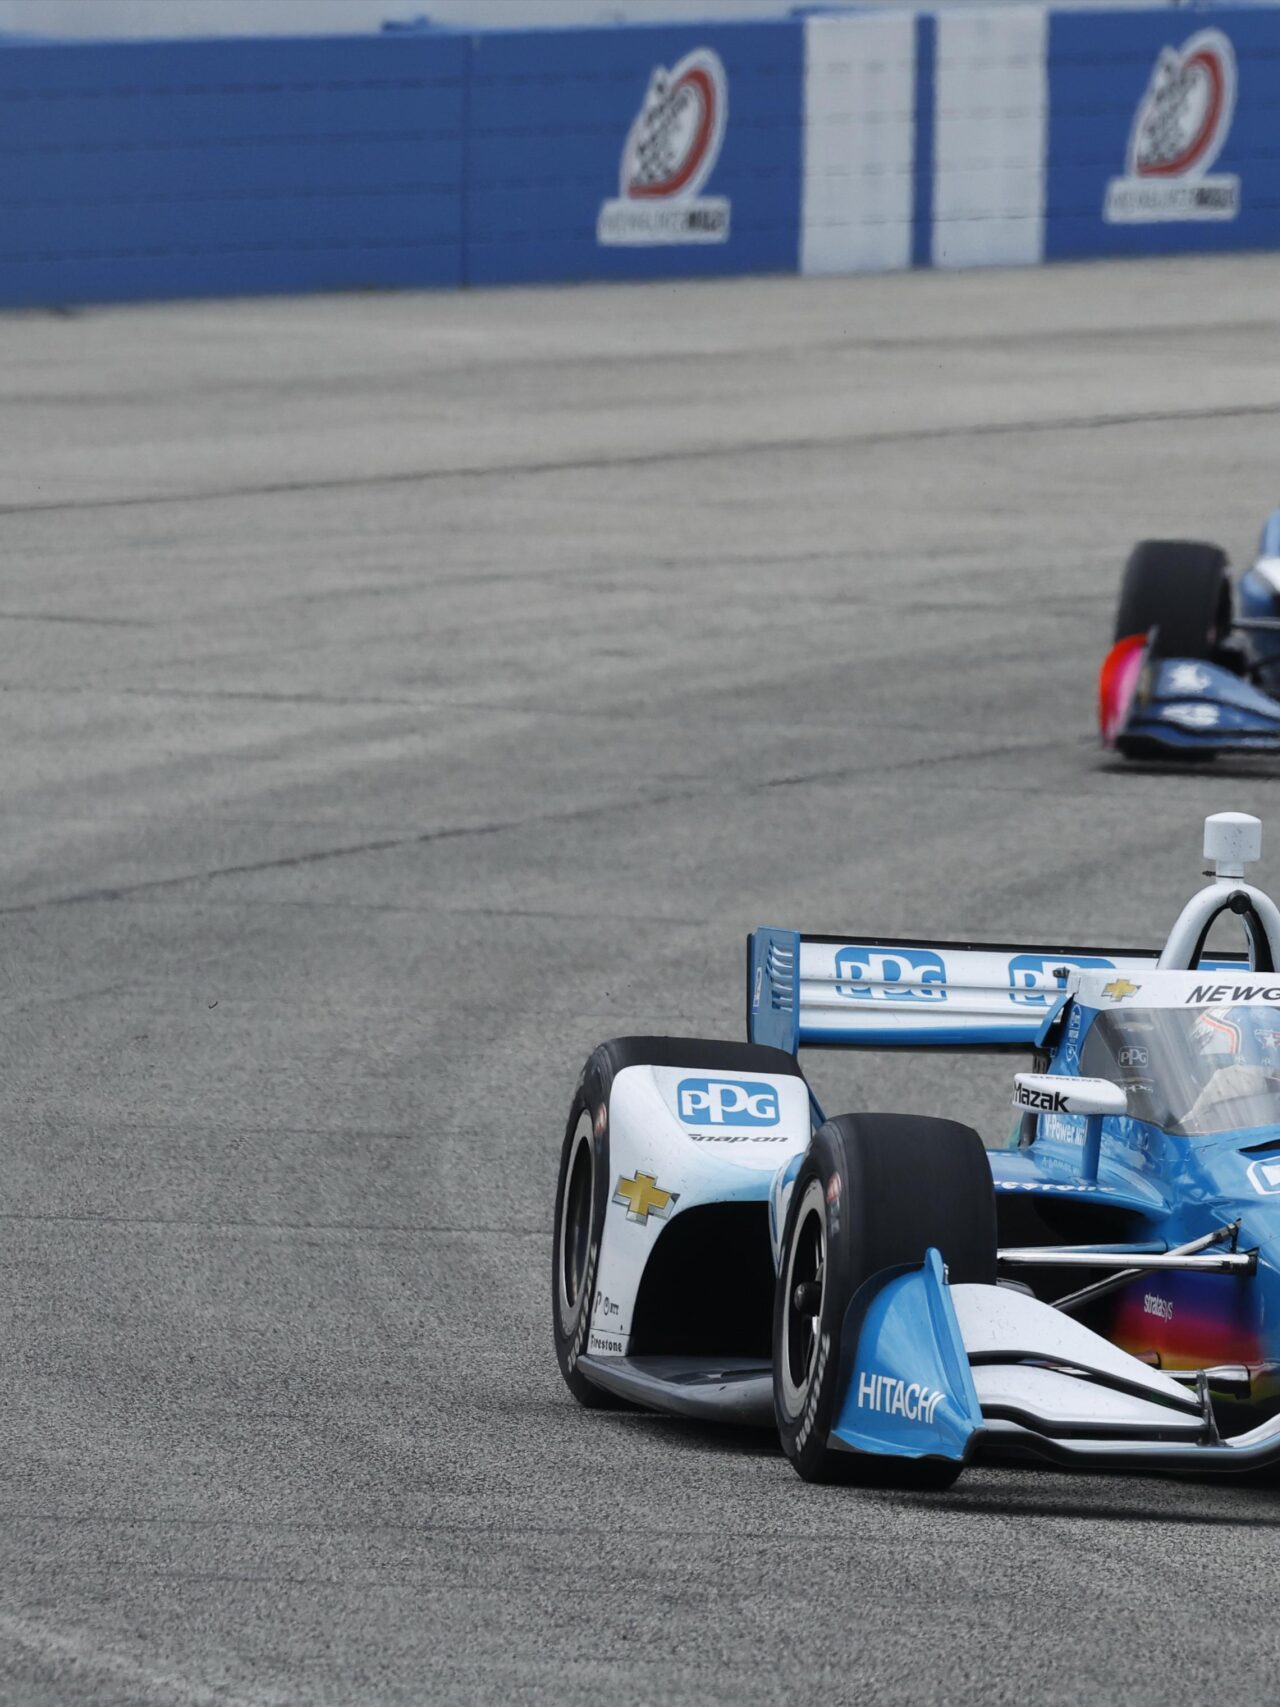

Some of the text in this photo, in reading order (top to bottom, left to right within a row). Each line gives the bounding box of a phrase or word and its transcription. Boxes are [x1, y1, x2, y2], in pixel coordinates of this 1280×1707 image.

[840, 953, 945, 999] PPG
[1120, 1049, 1147, 1065] PPG
[681, 1083, 776, 1123] PPG
[1014, 1081, 1070, 1113] Mazak
[590, 1334, 622, 1353] Firestone
[857, 1371, 946, 1425] HITACHI
